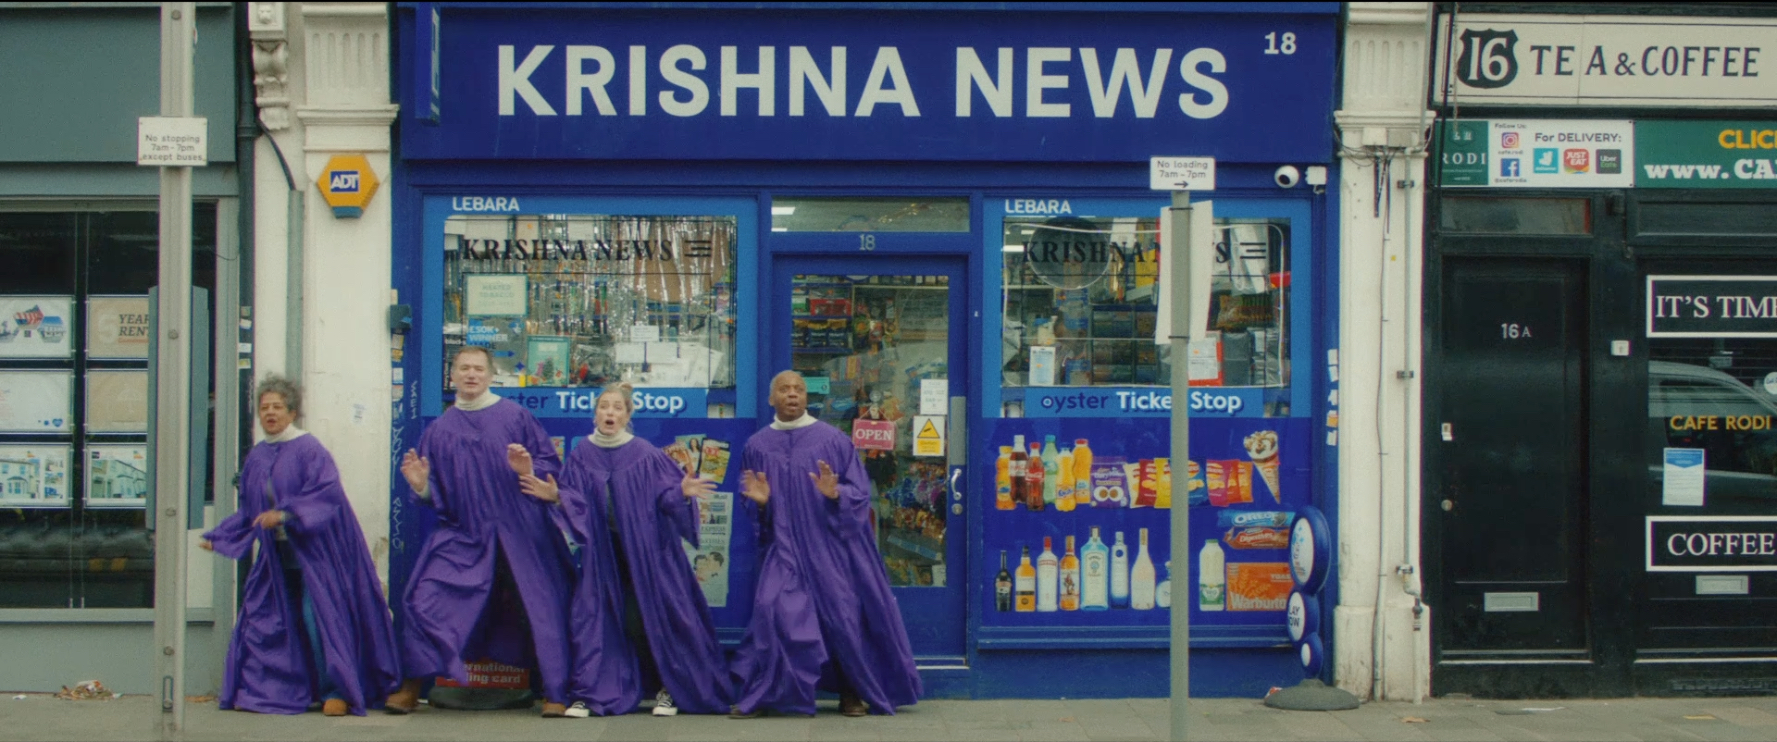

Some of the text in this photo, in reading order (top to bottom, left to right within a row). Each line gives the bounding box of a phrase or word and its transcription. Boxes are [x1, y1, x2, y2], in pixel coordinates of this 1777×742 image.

[1264, 32, 1297, 55] 18
[1467, 37, 1511, 81] 16
[1641, 46, 1761, 77] COFFEE
[497, 45, 921, 118] KRISHNA
[955, 46, 1230, 119] NEWS
[146, 134, 200, 144] No stopping
[1535, 133, 1622, 142] For DELIVERY:
[1718, 129, 1777, 149] CLIC
[142, 153, 203, 162] except buses
[1570, 158, 1587, 166] EAT
[1157, 160, 1208, 171] No loading
[330, 175, 359, 191] ADT
[452, 197, 520, 212] LEBARA
[1005, 199, 1072, 214] LEBARA
[462, 239, 673, 261] KRISHNA NEWS
[859, 235, 876, 250] 18
[1021, 241, 1146, 263] KRISHNA
[1655, 295, 1710, 318] IT'S
[555, 391, 598, 410] Tic
[632, 391, 684, 414] Stop
[1041, 391, 1242, 413] oyster Ticke Stop
[1670, 416, 1772, 431] CAFE RODI
[855, 428, 893, 441] OPEN
[1667, 532, 1776, 556] COFFEE
[1230, 591, 1287, 610] Warburto
[1289, 606, 1301, 616] LAY
[1289, 616, 1300, 628] OW
[491, 674, 521, 684] card
